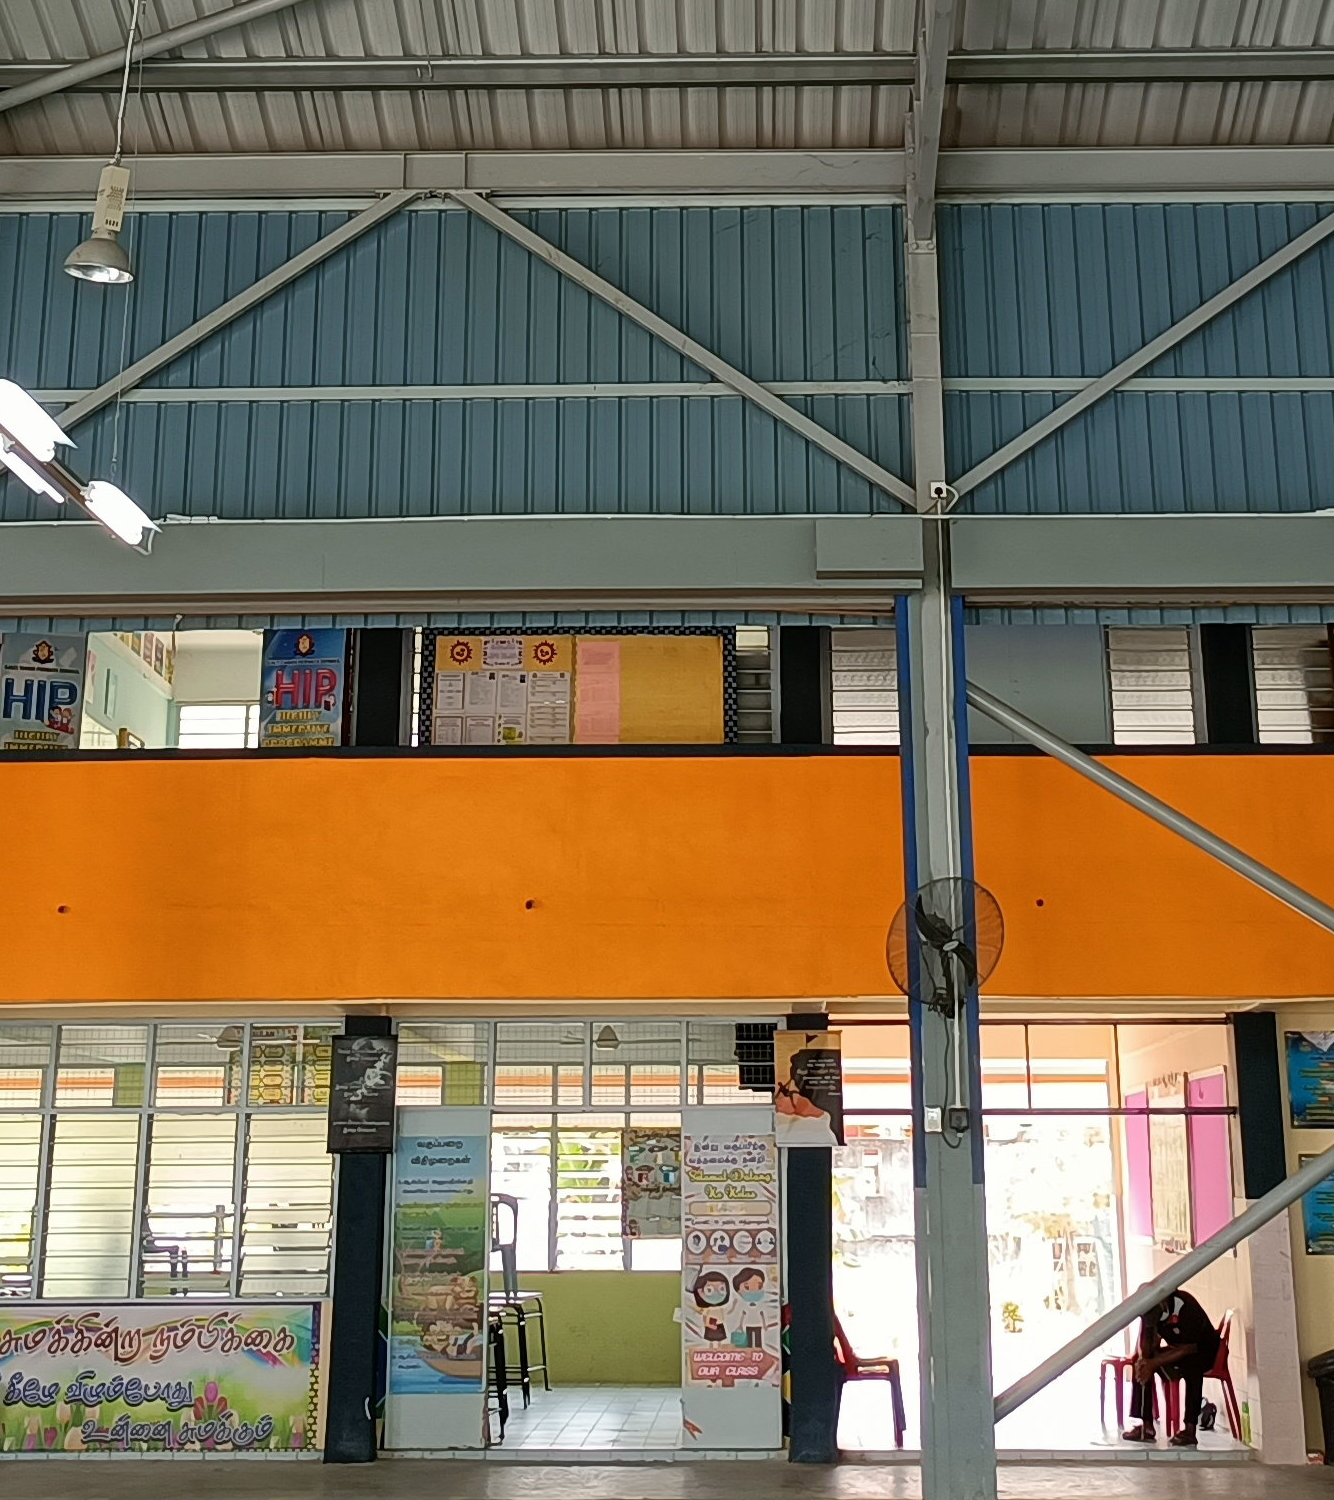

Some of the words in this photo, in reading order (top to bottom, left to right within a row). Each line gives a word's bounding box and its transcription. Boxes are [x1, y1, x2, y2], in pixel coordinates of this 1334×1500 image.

[3, 677, 78, 721] HIP
[275, 668, 337, 708] HIP
[150, 1311, 296, 1364] நம்பிக்கை
[693, 1352, 746, 1361] WELCOME
[751, 1352, 764, 1361] TO
[697, 1366, 720, 1376] OUR
[725, 1366, 759, 1376] CLASS
